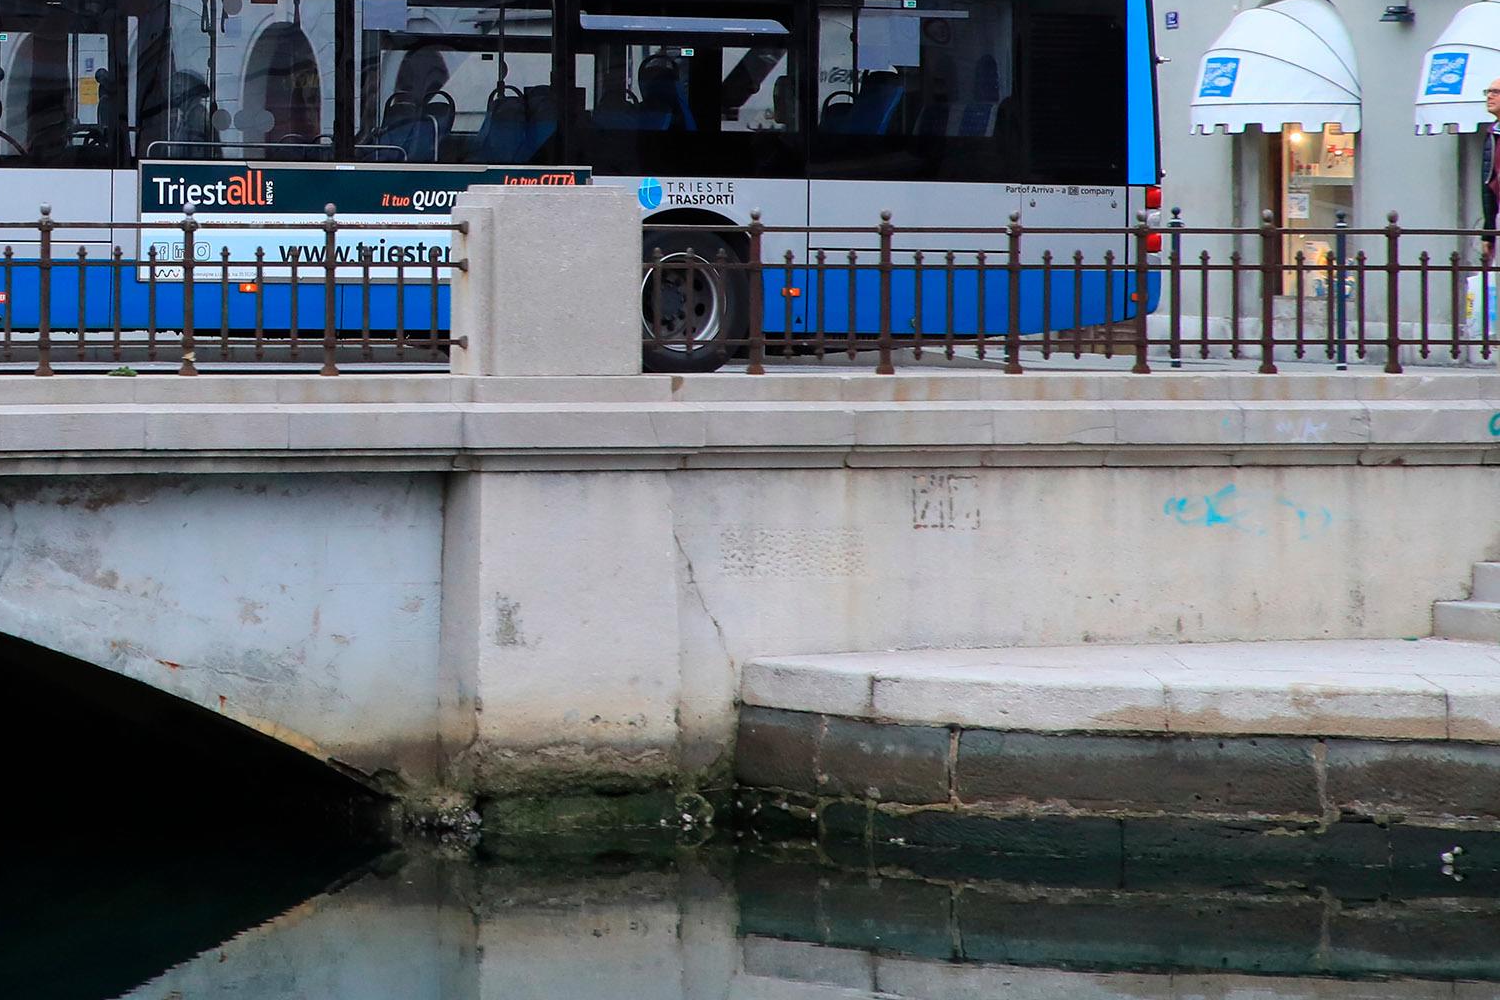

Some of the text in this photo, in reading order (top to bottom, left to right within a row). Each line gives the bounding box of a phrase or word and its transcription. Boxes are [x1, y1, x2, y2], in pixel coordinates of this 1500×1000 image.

[540, 171, 576, 185] CITTÀ
[265, 180, 274, 205] NEWS
[666, 182, 734, 193] TRIESTE
[1031, 185, 1054, 194] Arriva
[1080, 187, 1115, 197] company
[382, 190, 457, 211] il tuo QUOT
[667, 194, 735, 205] TRASPORTI
